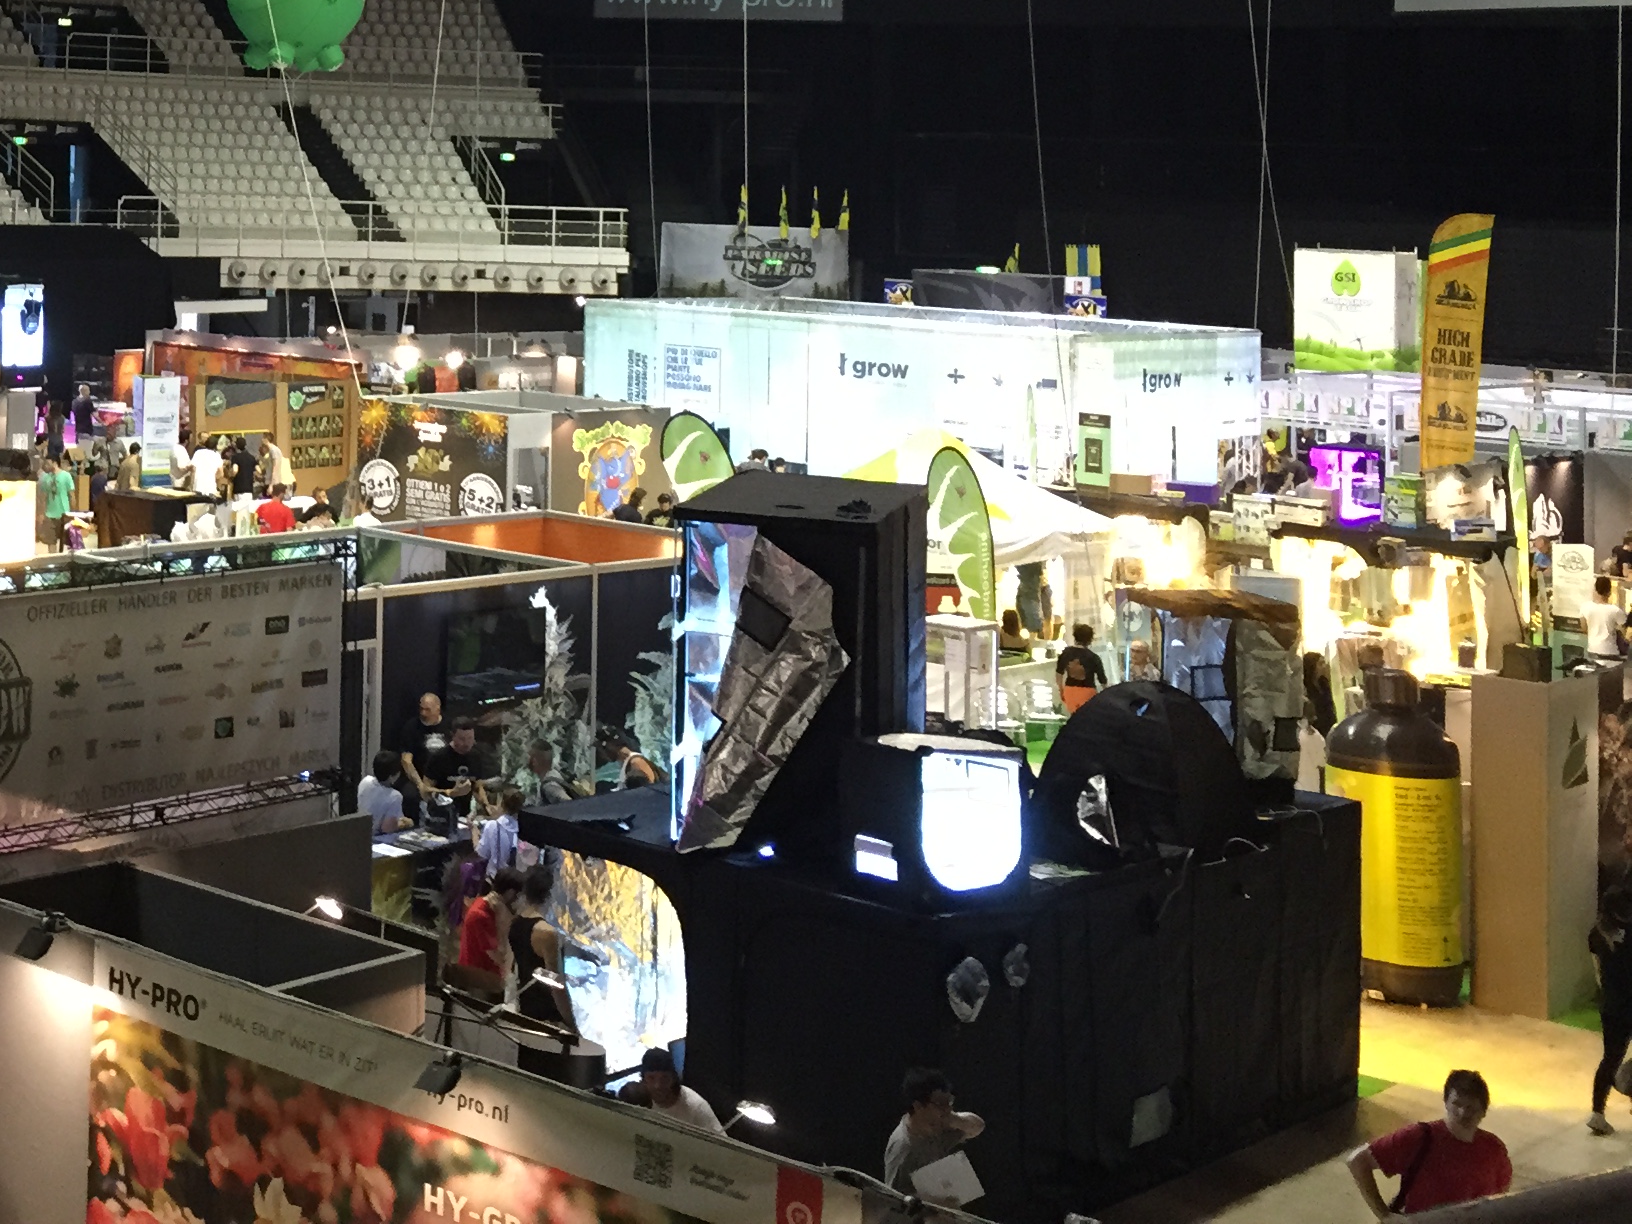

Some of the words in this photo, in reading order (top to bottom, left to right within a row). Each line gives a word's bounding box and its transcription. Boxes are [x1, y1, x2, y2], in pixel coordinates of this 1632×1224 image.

[1334, 271, 1356, 283] GSI
[1437, 328, 1471, 348] HIGH
[1430, 346, 1475, 368] GRADE
[852, 360, 909, 379] grow
[1149, 370, 1182, 393] grow
[26, 598, 108, 623] OFFIZIELLER
[186, 586, 212, 604] DER
[220, 579, 269, 600] BESTEN
[277, 574, 333, 594] MARKEN
